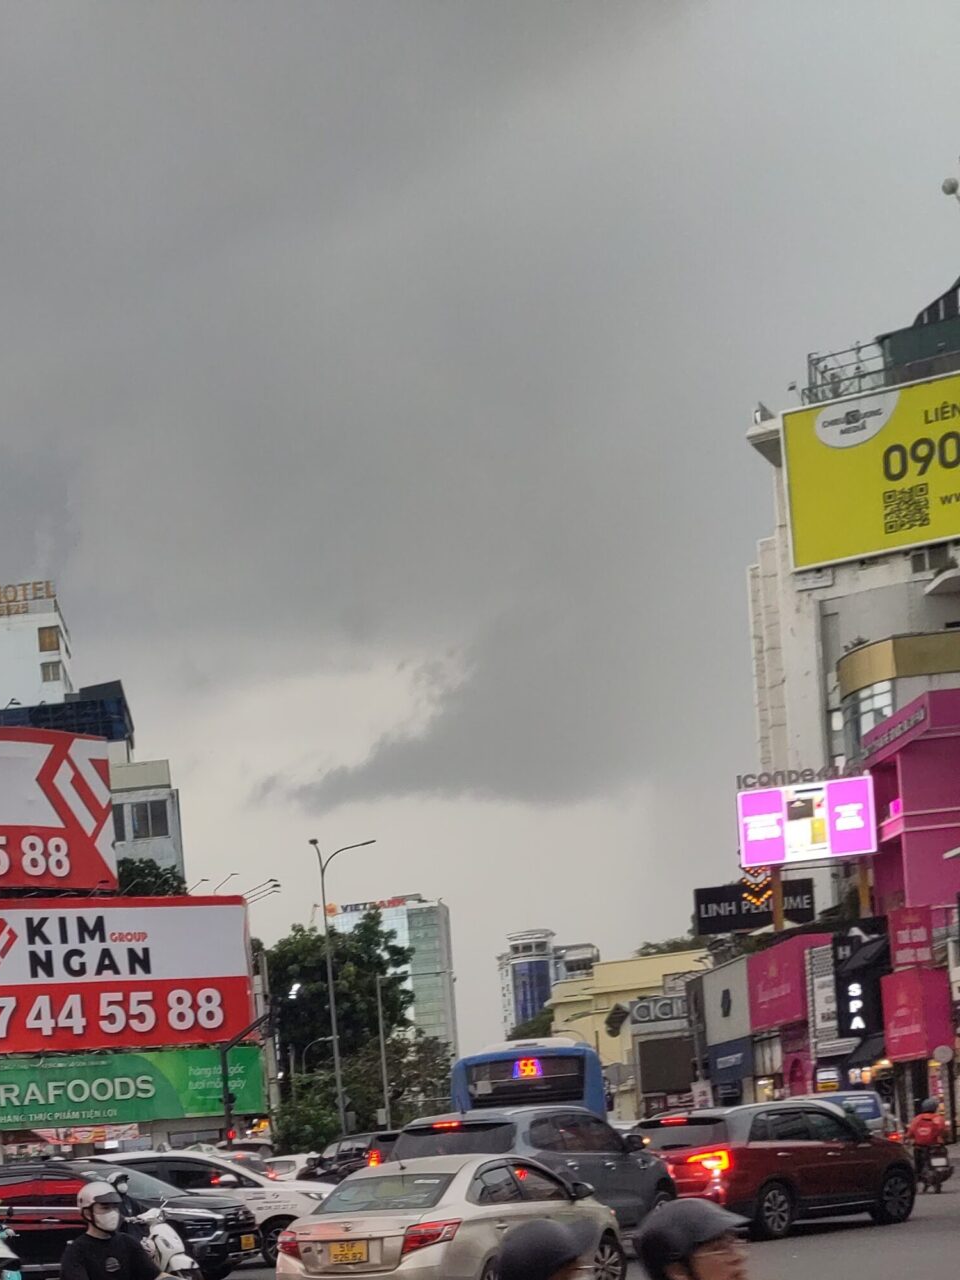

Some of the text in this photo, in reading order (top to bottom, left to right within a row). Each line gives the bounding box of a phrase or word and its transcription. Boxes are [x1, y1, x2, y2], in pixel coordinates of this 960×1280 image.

[20, 835, 71, 877] 88
[699, 894, 812, 919] LINH PERUME
[25, 915, 149, 946] KIM GROUP
[28, 947, 152, 979] NGAN
[25, 994, 86, 1036] 44
[98, 991, 156, 1034] 55
[167, 988, 225, 1031] 88
[847, 982, 866, 1030] SPA
